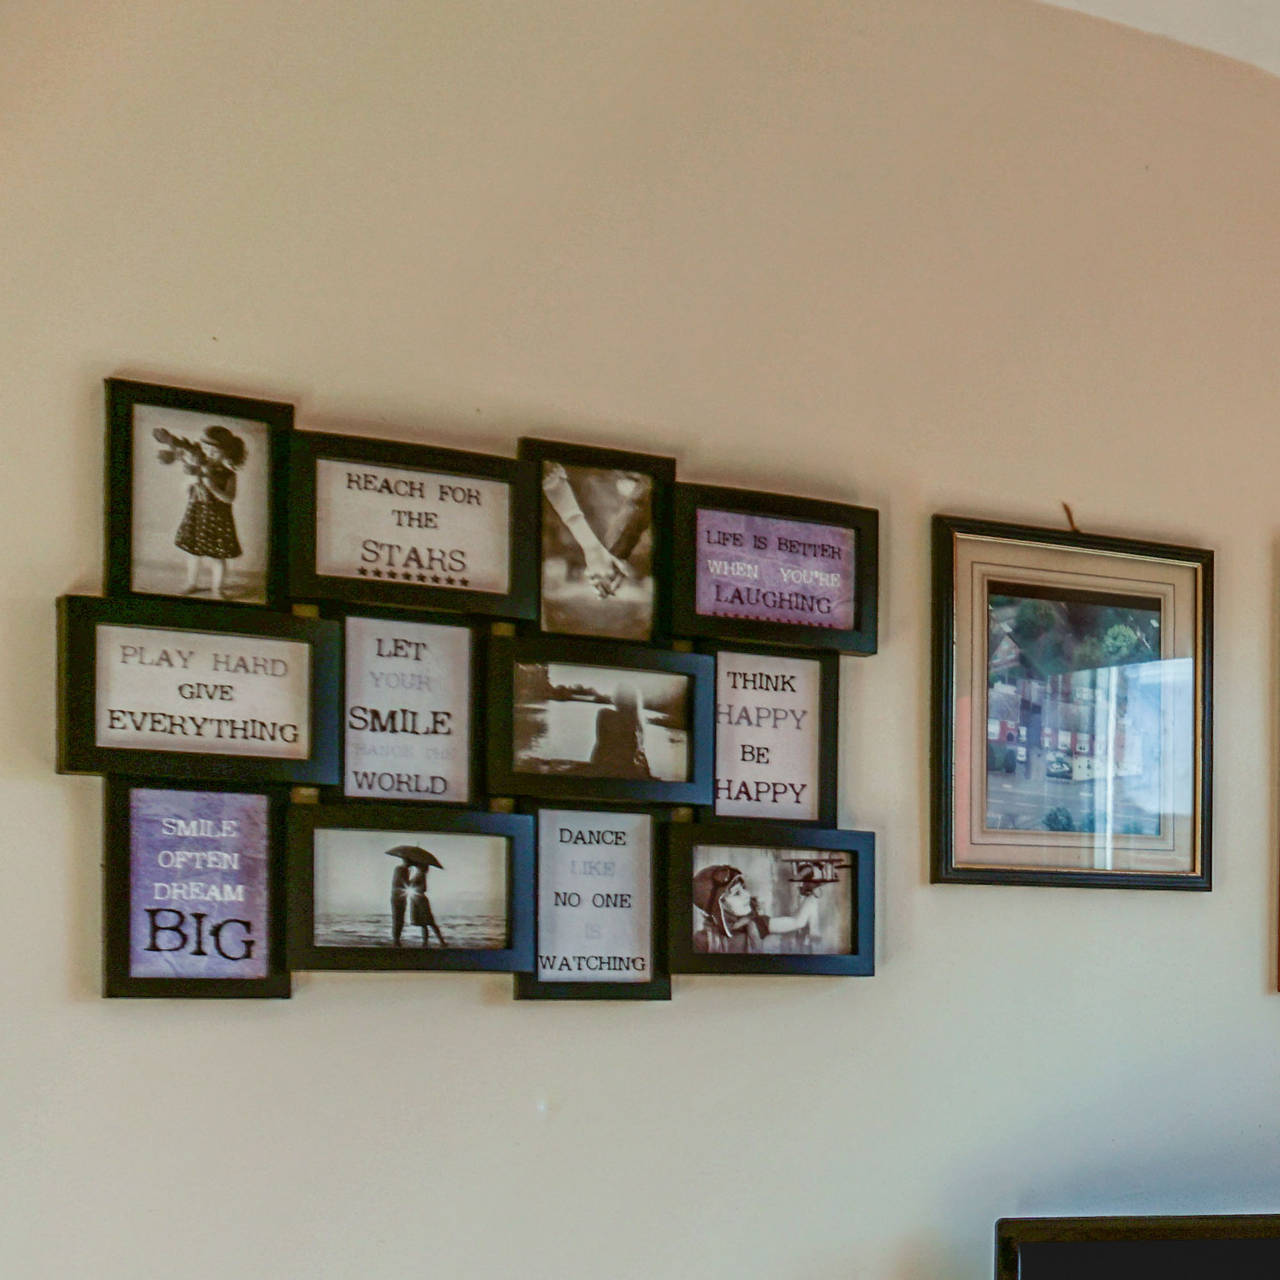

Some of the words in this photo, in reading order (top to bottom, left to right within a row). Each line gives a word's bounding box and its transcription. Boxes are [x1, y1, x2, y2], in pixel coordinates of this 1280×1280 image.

[347, 472, 425, 499] REACH
[439, 485, 482, 506] FOR
[391, 508, 439, 530] THE
[361, 539, 468, 573] STARS
[706, 530, 744, 548] LIFE
[753, 533, 768, 550] IS
[777, 536, 842, 560] BETTER
[707, 559, 759, 580] WHEN
[780, 567, 841, 587] YOU'RE
[715, 584, 832, 615] LAUGHING
[119, 644, 195, 669] PLAY
[212, 652, 289, 678] HARD
[376, 637, 427, 661] LET
[177, 682, 235, 702] GIVE
[369, 670, 432, 692] YOUR
[726, 671, 797, 693] THINK
[107, 709, 300, 745] EVERYTHING
[349, 705, 452, 736] SMILE
[716, 703, 808, 731] HAPPY
[740, 744, 770, 765] BE
[352, 770, 448, 796] WORLD
[715, 778, 808, 804] HAPPY
[161, 819, 238, 838] SMILE
[559, 827, 627, 846] DANCE
[157, 850, 240, 871] OFTEN
[569, 859, 617, 878] LIKE
[152, 881, 245, 902] DREAM
[554, 891, 582, 909] NO
[592, 893, 632, 909] ONE
[143, 907, 256, 961] BIG
[538, 954, 647, 972] WATCHING
